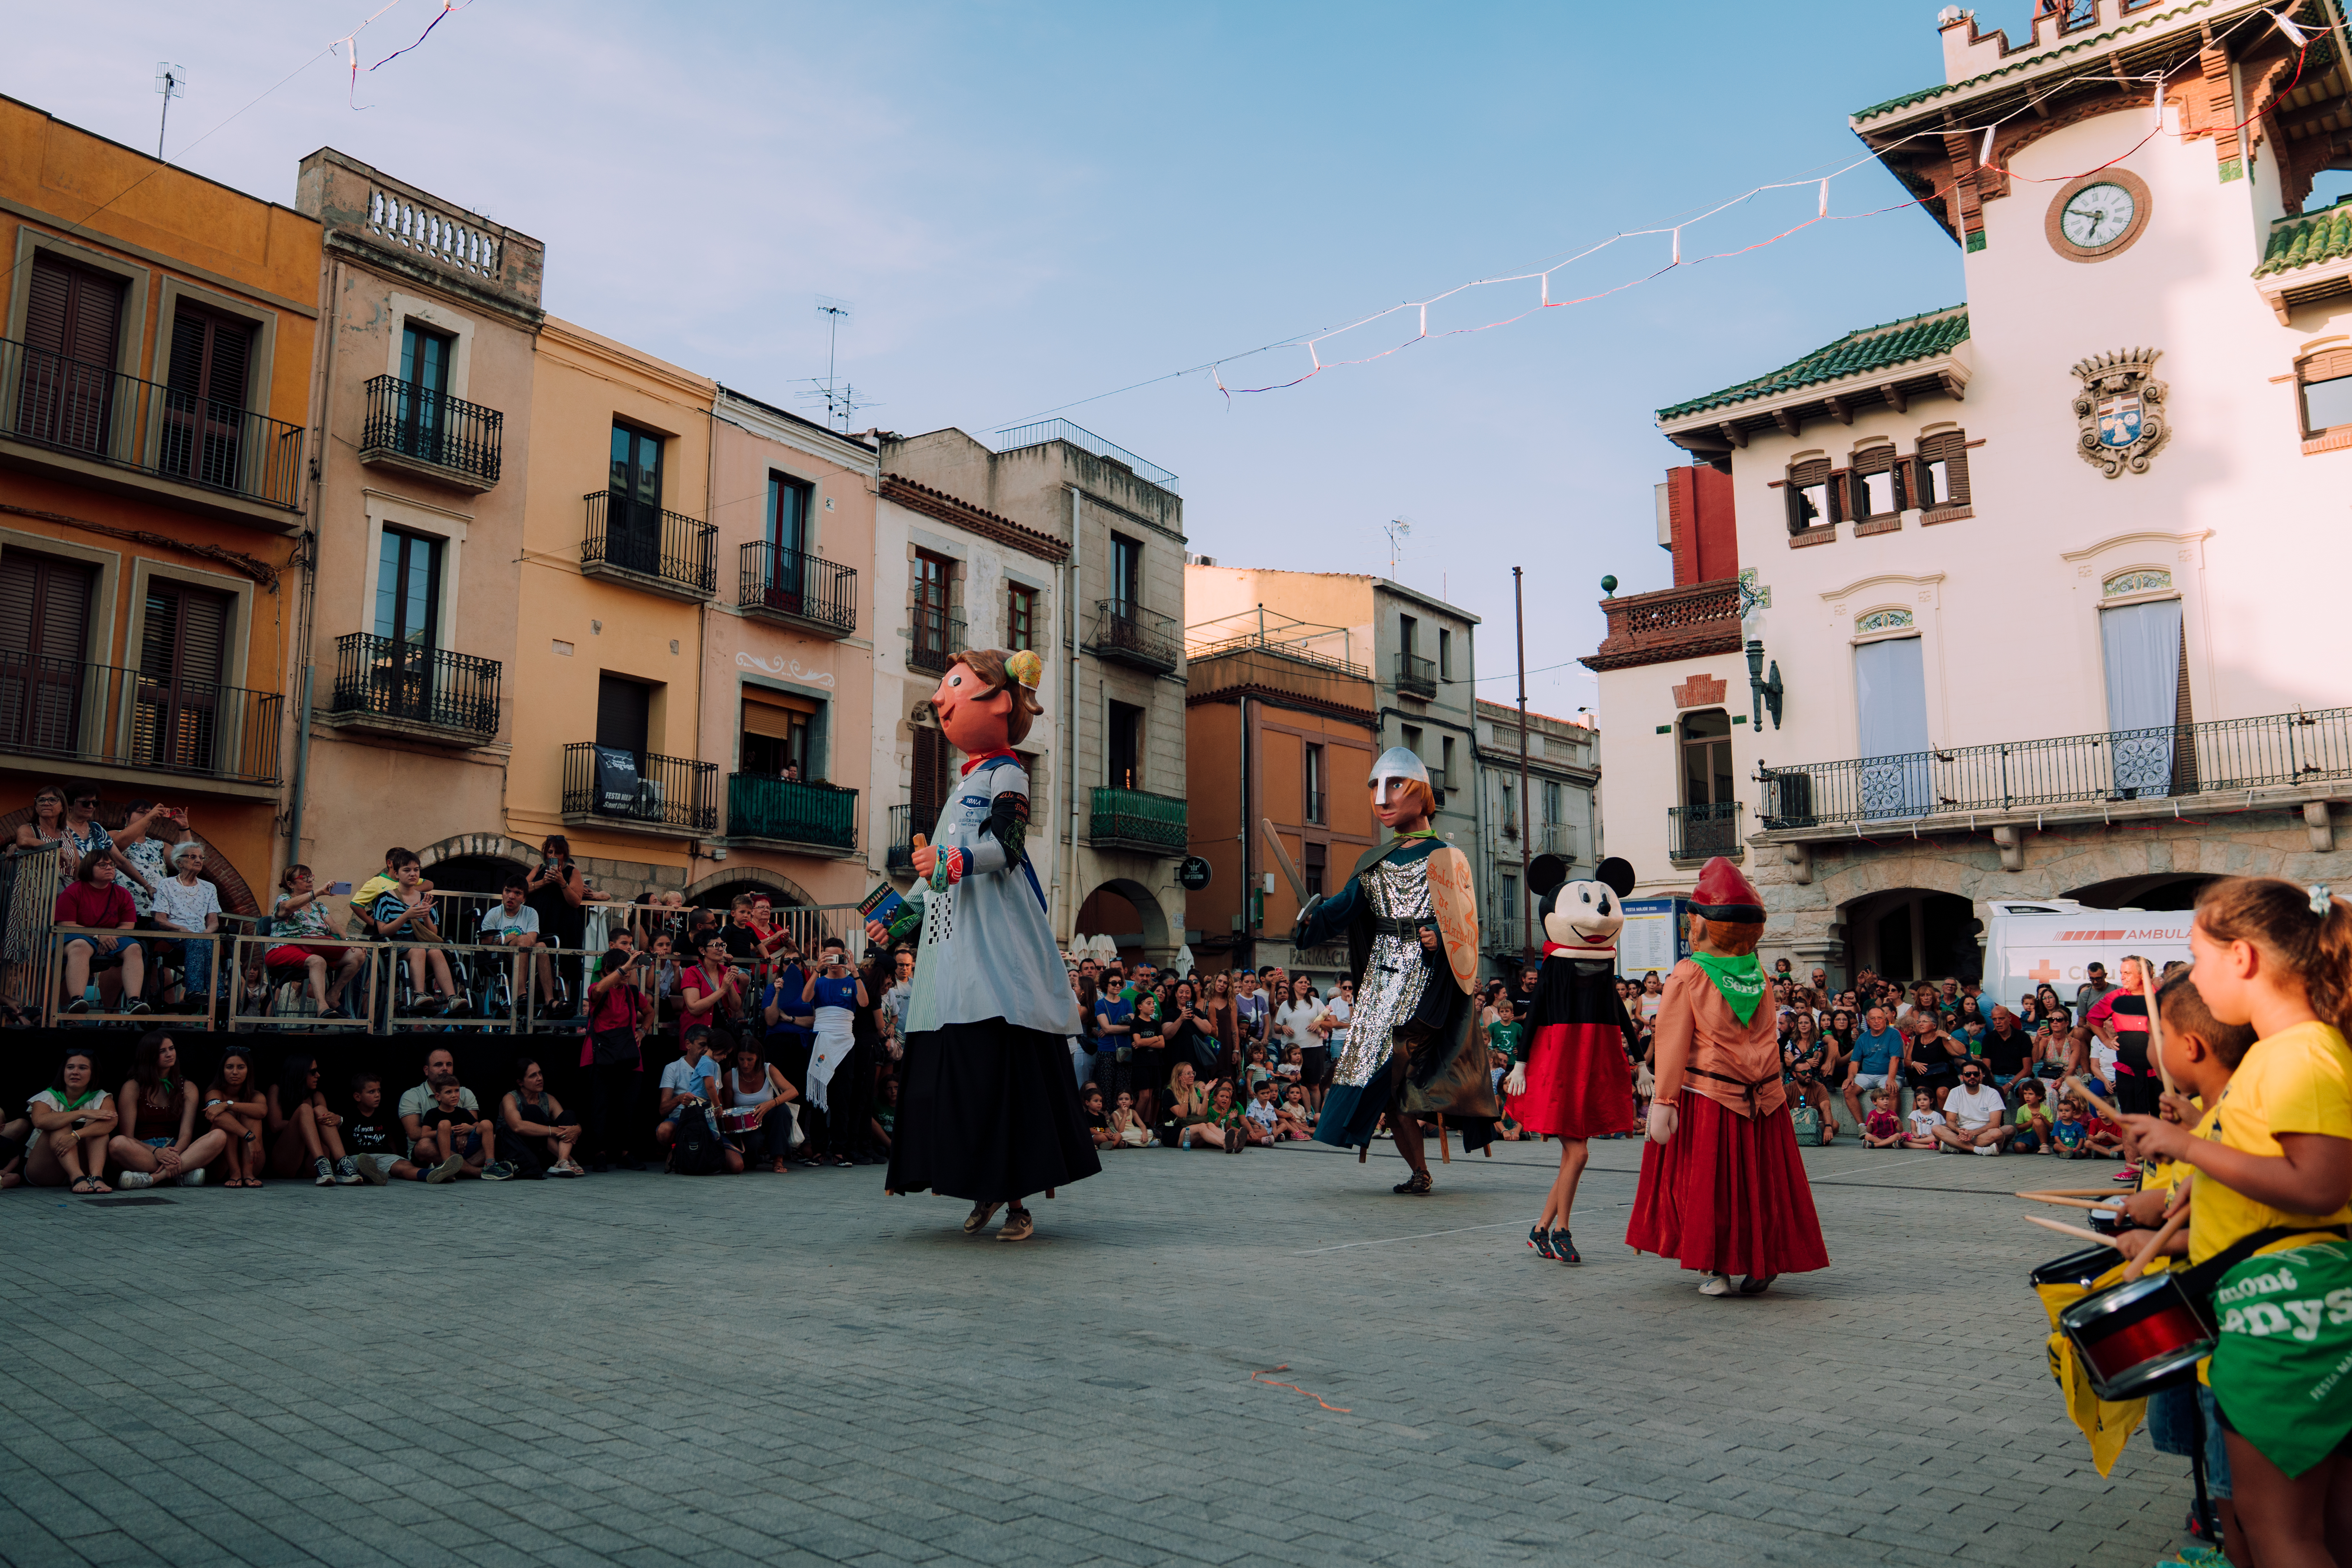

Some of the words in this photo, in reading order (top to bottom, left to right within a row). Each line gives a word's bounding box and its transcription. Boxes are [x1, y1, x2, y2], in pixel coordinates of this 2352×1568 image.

[605, 792, 621, 800] FESTA
[1427, 863, 1454, 889] Soler
[1437, 889, 1449, 910] de
[2068, 966, 2115, 980] Cru
[1722, 975, 1766, 994] Senys
[879, 1112, 894, 1121] Sen
[2218, 1267, 2298, 1305] mont
[2309, 1373, 2340, 1401] FESTA
